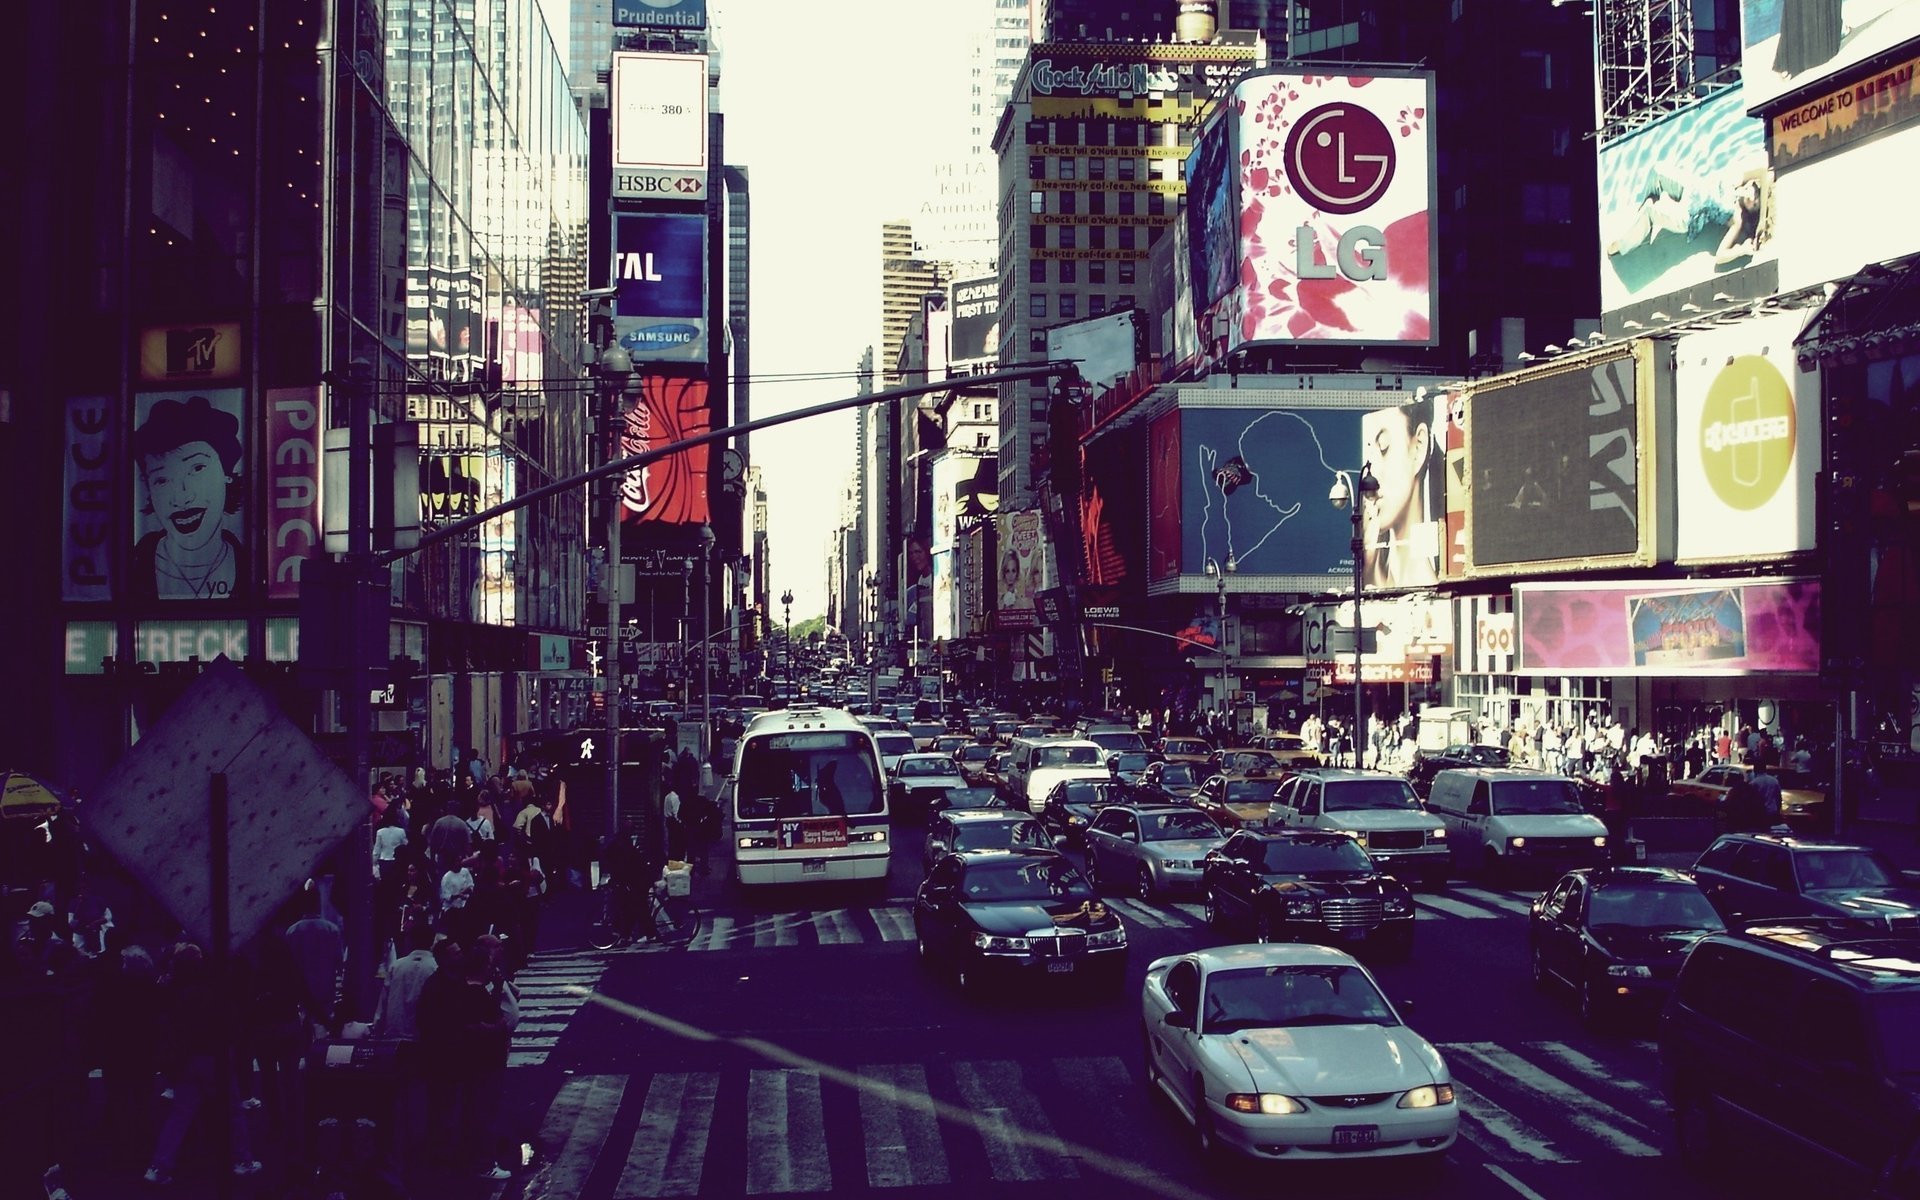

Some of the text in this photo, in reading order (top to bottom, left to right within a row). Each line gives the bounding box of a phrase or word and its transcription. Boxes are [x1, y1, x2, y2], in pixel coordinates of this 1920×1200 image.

[617, 8, 701, 26] Prudential
[1780, 64, 1914, 132] WELCOME TO NEW
[661, 104, 683, 115] 380
[617, 175, 672, 193] HSBC
[1295, 225, 1389, 282] LG
[629, 331, 691, 344] SAMSUNG
[166, 327, 222, 372] MTV
[206, 580, 232, 600] yo.
[1083, 606, 1120, 614] LOEWS
[621, 627, 637, 636] WAY
[557, 679, 566, 690] W
[569, 679, 584, 690] 44
[782, 822, 799, 832] NY
